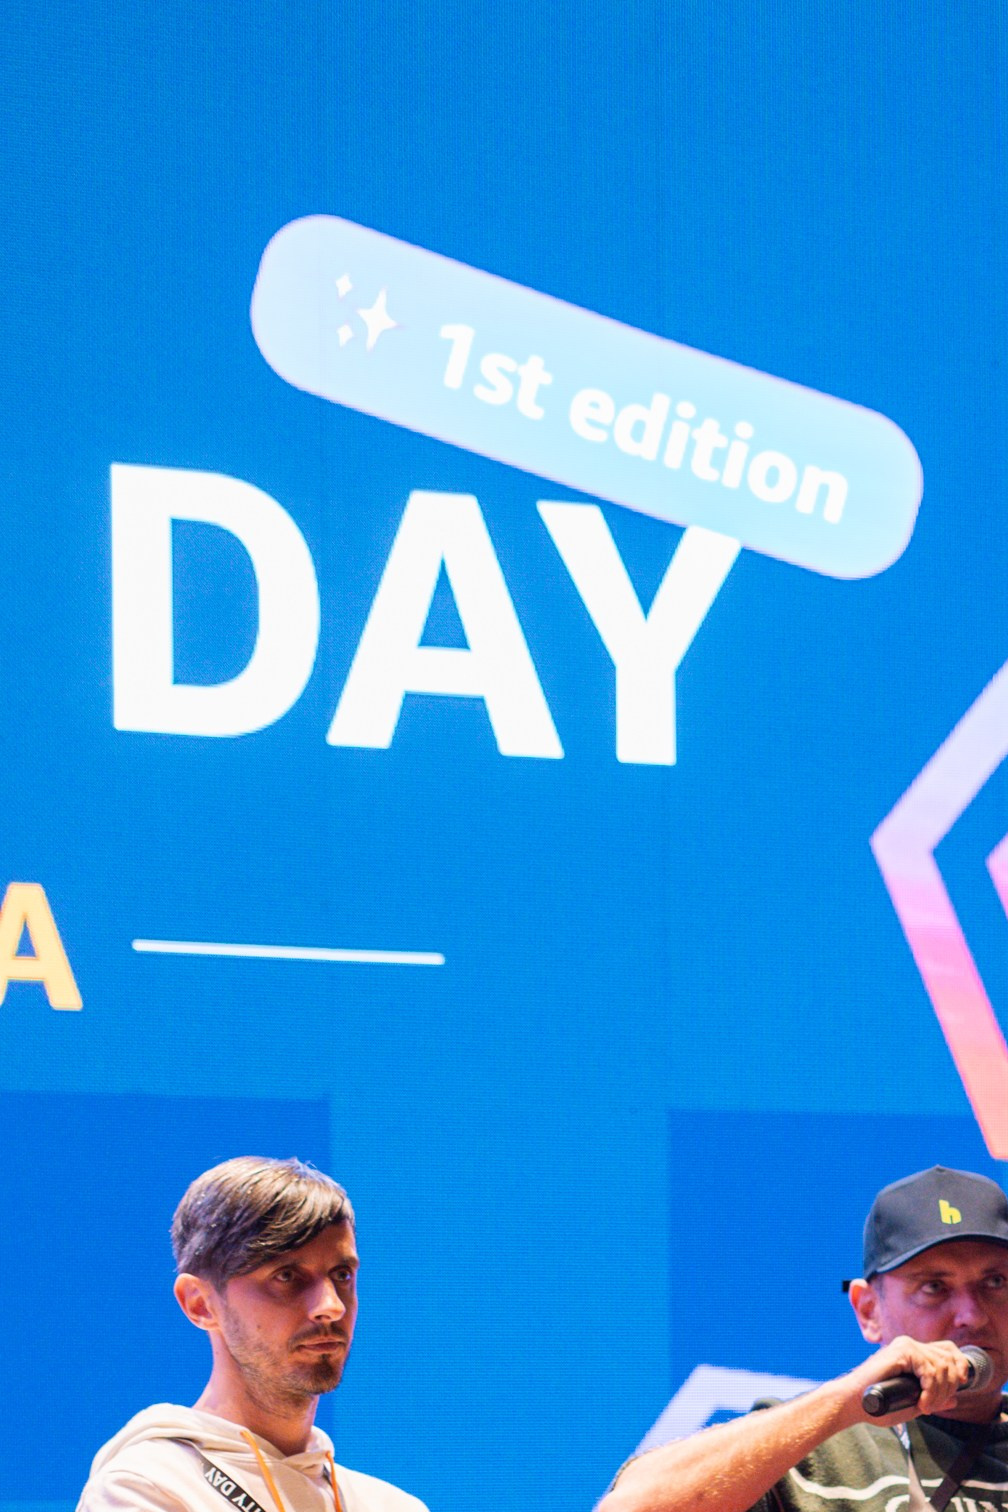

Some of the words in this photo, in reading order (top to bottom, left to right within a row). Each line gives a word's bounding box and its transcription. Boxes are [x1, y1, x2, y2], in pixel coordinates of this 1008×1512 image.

[439, 323, 553, 420] 1st
[569, 388, 848, 525] edition
[110, 462, 743, 767] DAY
[204, 1466, 237, 1498] DAY
